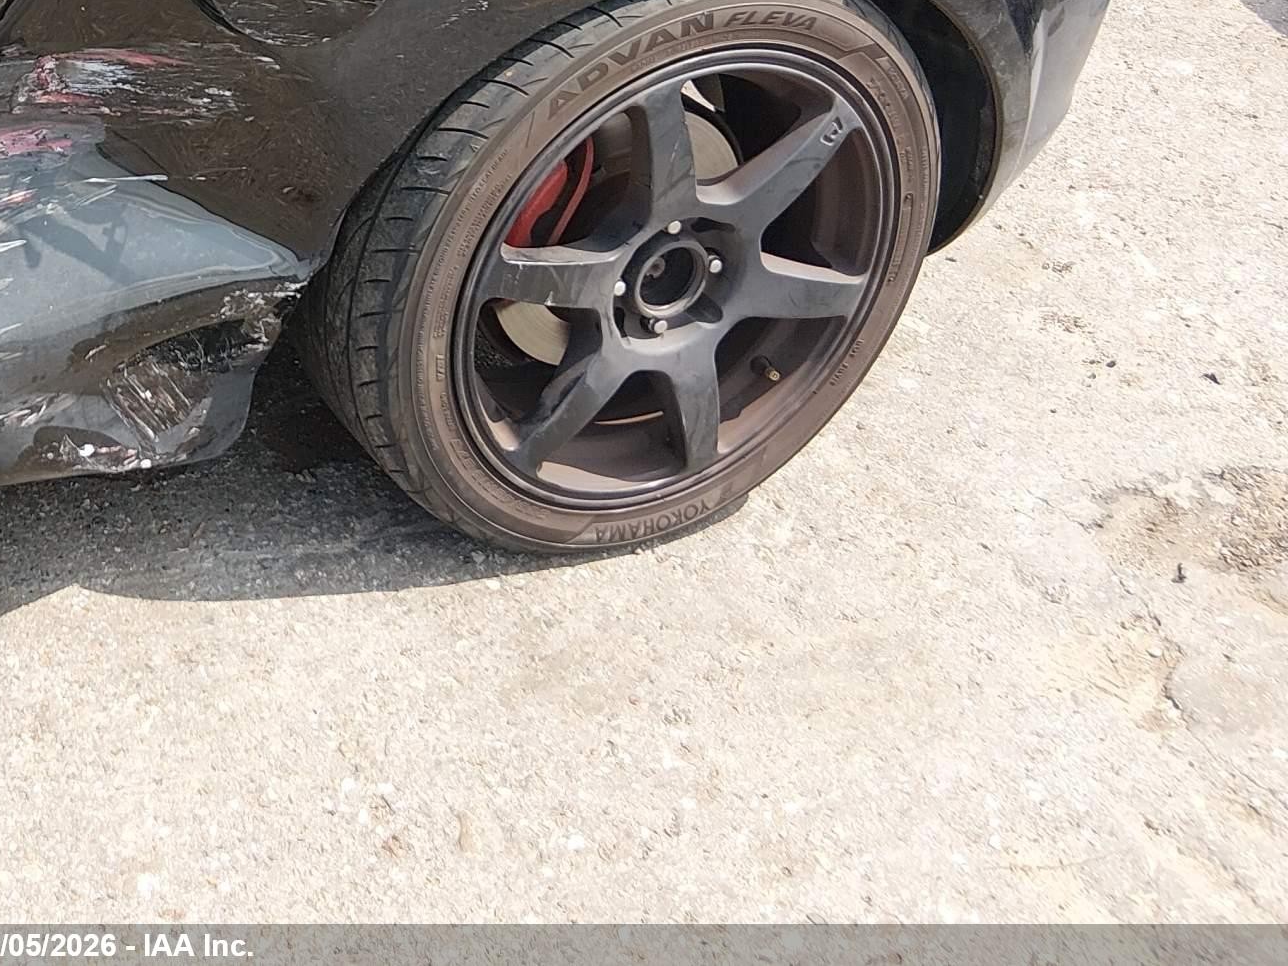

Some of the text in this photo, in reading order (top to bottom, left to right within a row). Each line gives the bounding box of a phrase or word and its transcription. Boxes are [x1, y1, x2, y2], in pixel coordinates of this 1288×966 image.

[548, 10, 714, 120] ADVAN
[722, 10, 819, 32] FLEVA
[595, 499, 711, 543] YOKOHAMA
